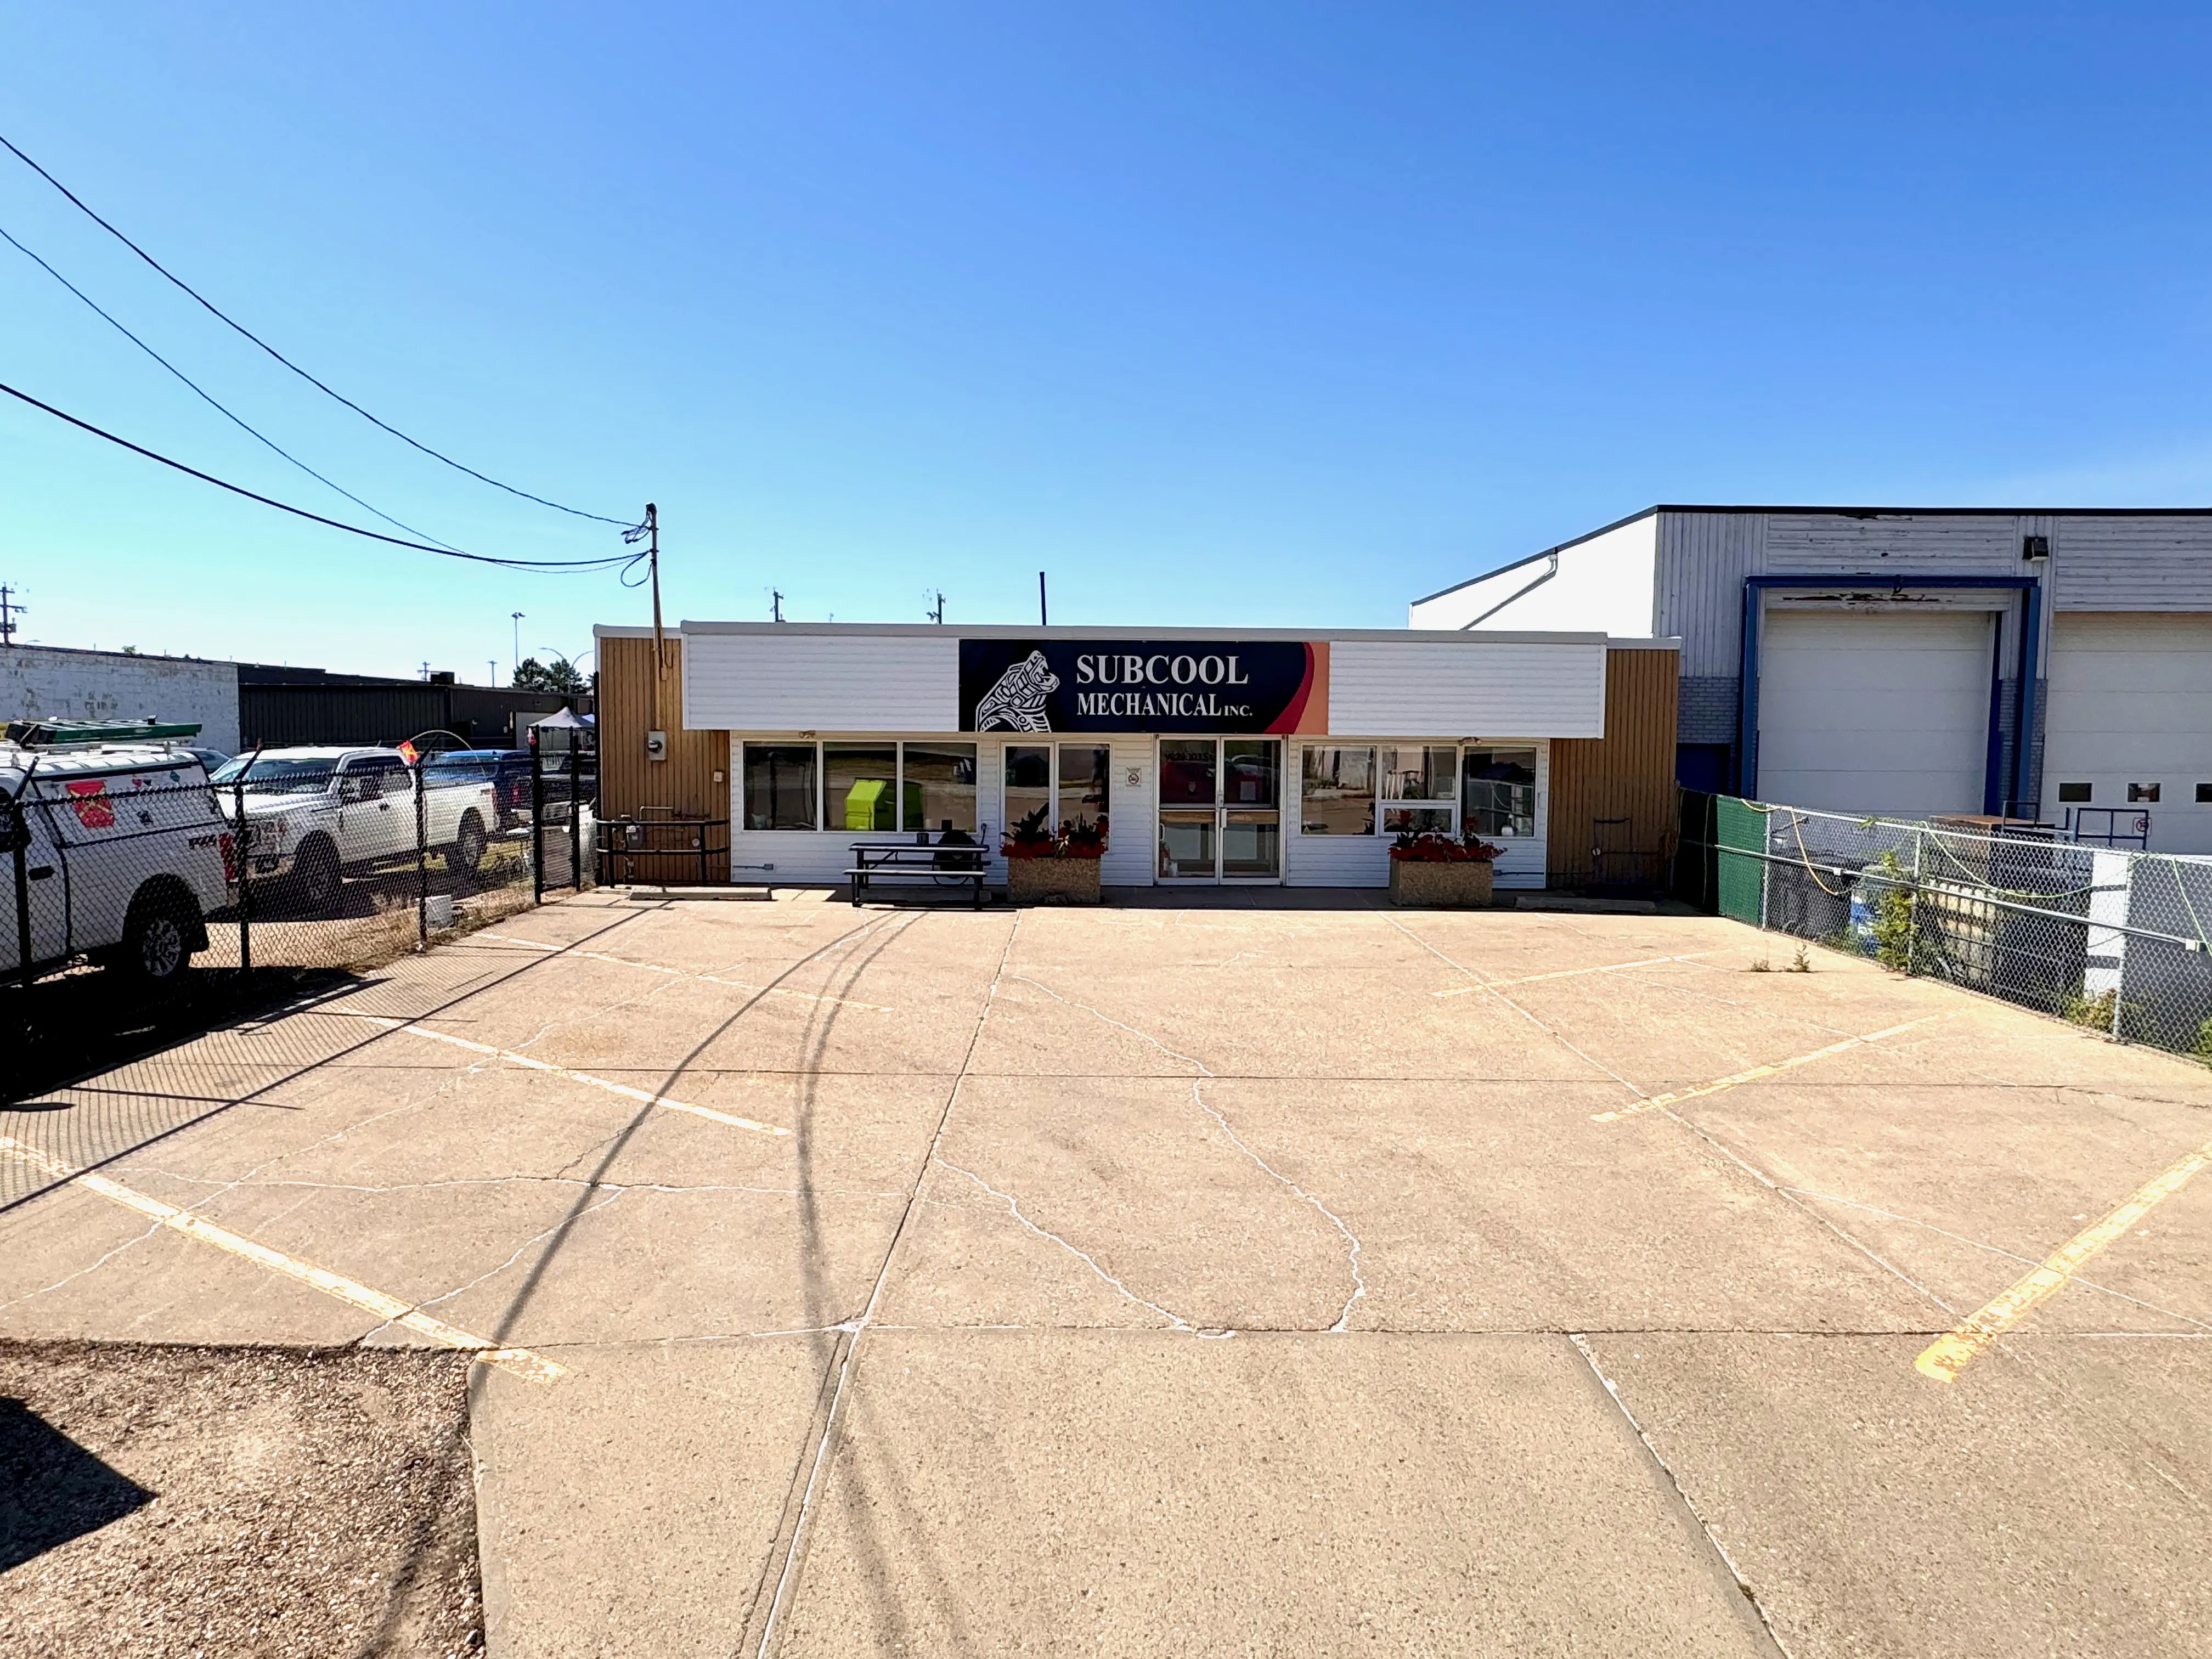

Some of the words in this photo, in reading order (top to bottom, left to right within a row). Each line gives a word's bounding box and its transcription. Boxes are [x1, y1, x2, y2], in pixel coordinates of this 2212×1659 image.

[1076, 654, 1249, 684] SUBCOOL
[1076, 692, 1222, 716] MECHANICAL
[1223, 705, 1253, 716] INC.
